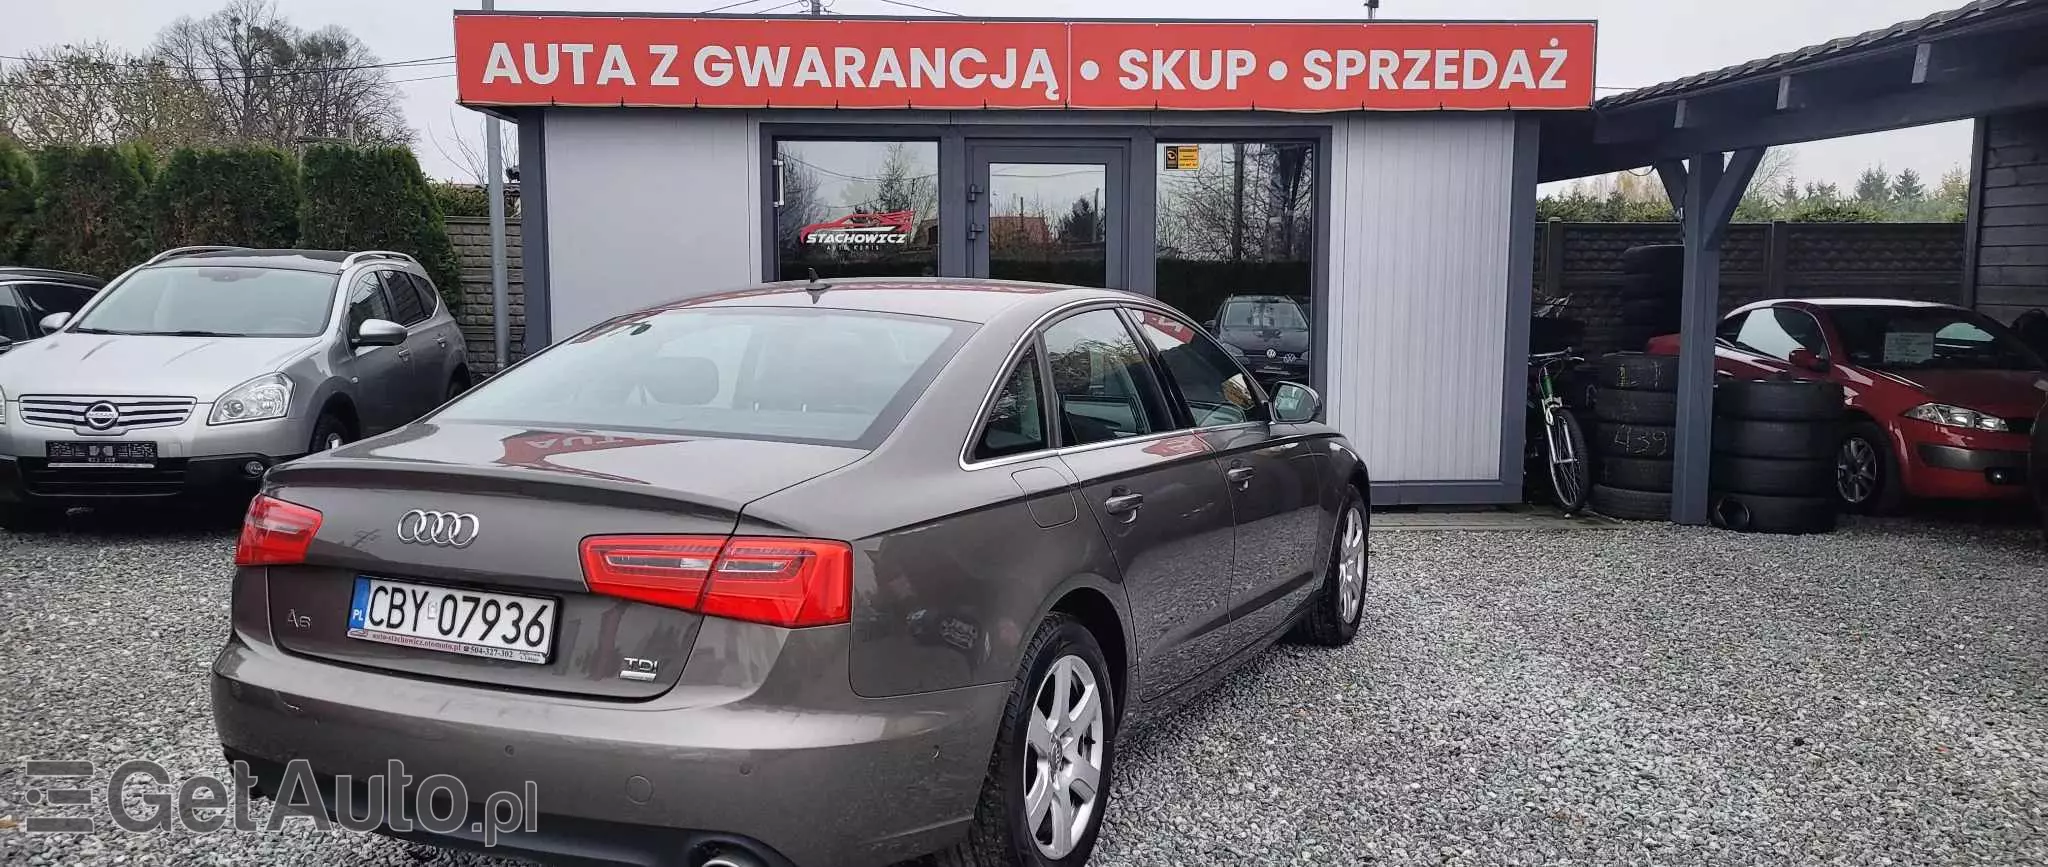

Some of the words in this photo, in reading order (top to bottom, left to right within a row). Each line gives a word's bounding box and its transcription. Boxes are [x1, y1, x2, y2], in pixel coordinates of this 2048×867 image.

[482, 42, 637, 86] AUTA
[648, 44, 680, 86] Z
[693, 45, 1060, 101] GWARANCJĄ
[1118, 48, 1257, 91] SKUP
[1302, 37, 1568, 91] SPRZEDAŻ
[806, 233, 907, 244] STACHOWICZ
[287, 608, 311, 629] A6
[352, 608, 364, 621] PL
[368, 585, 430, 632] CBY
[437, 593, 548, 648] 07936
[623, 657, 658, 671] TDI
